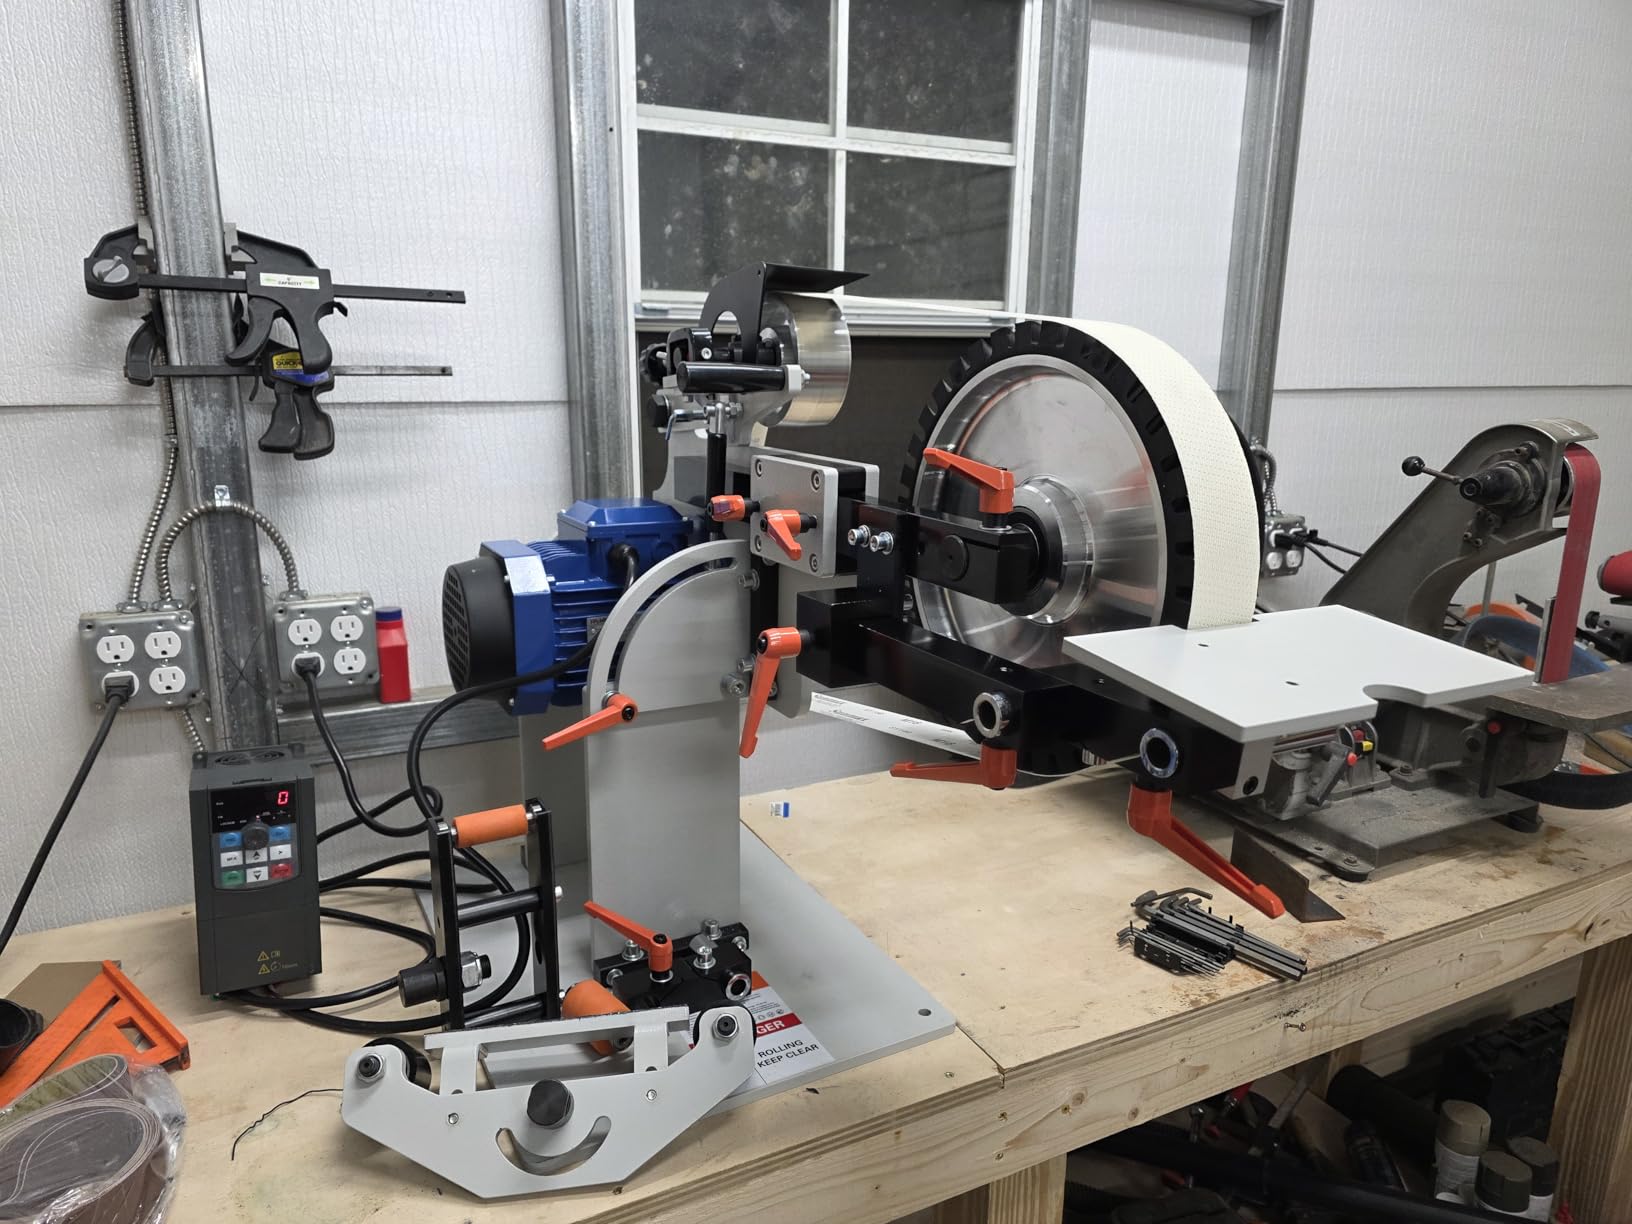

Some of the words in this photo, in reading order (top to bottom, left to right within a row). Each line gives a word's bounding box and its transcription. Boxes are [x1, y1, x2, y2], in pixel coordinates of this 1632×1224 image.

[277, 791, 289, 805] 0
[757, 1020, 785, 1034] GER
[757, 1039, 803, 1058] ROLLING
[757, 1055, 783, 1068] KEEP
[786, 1043, 820, 1059] CLEAR
